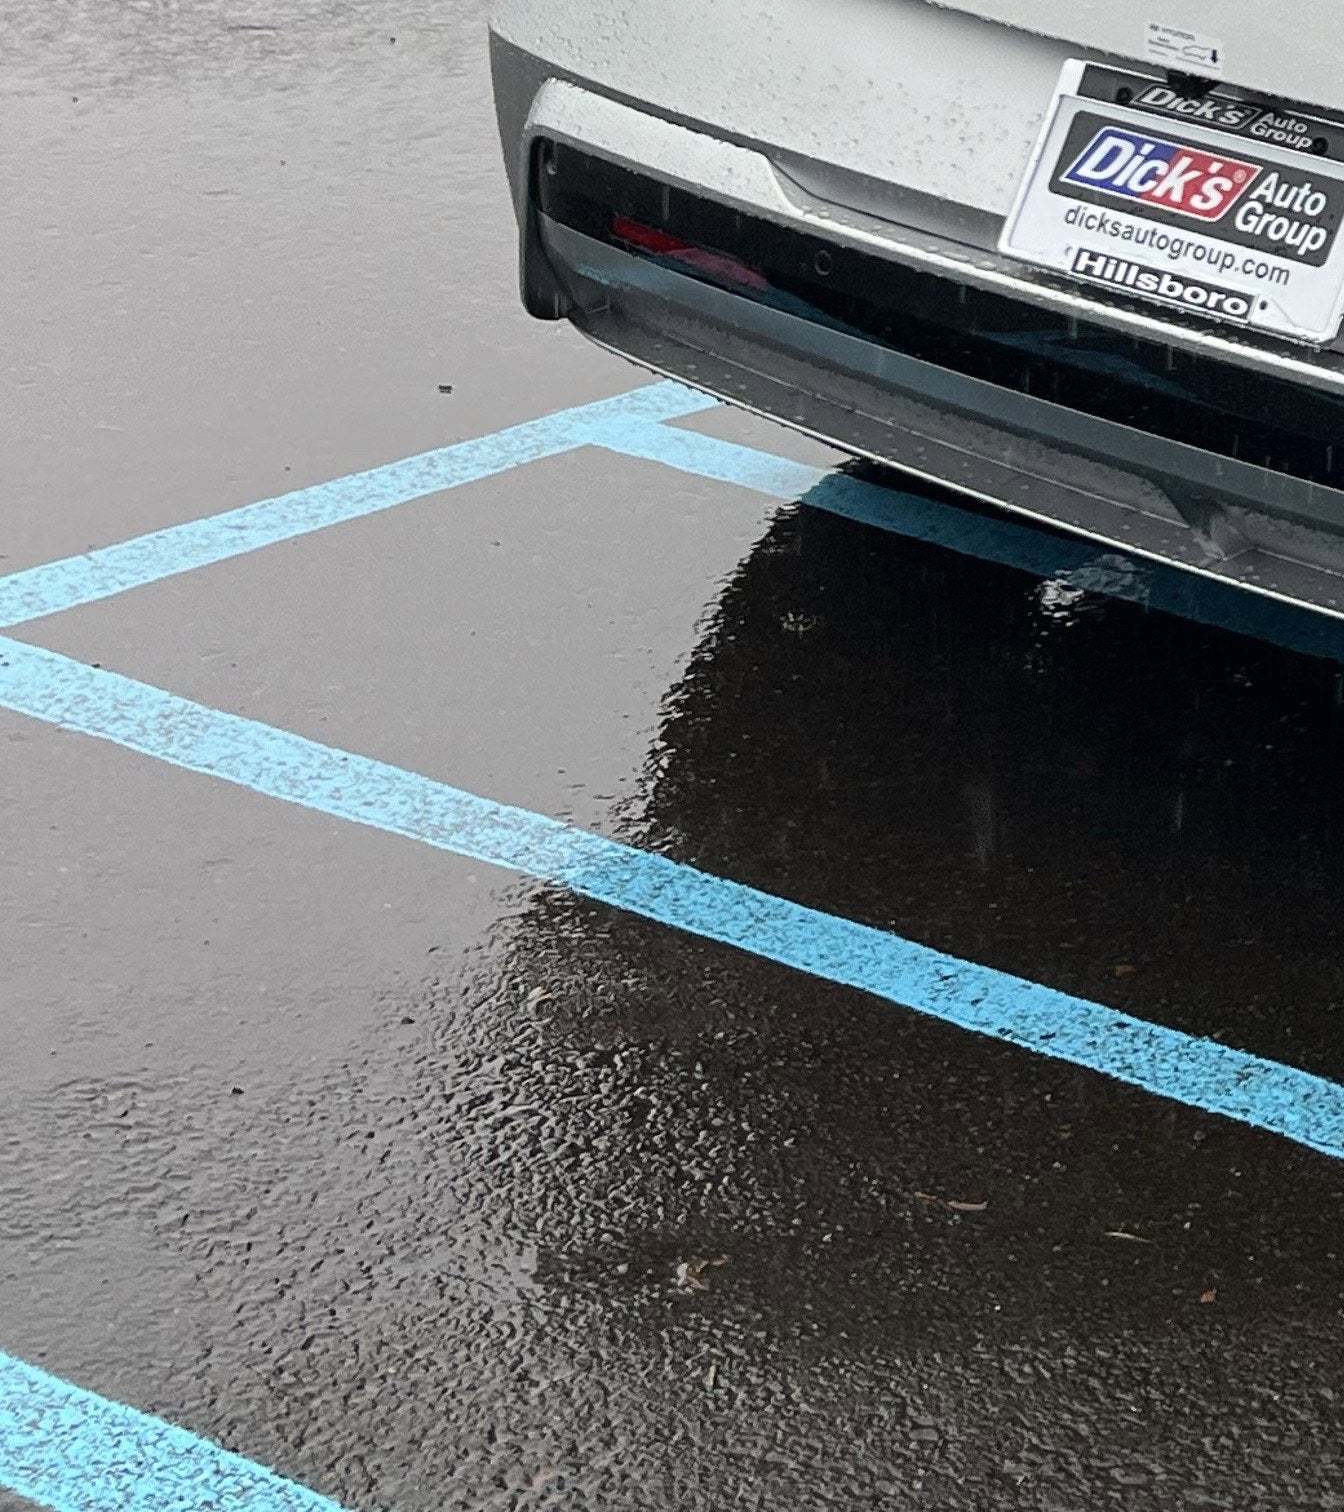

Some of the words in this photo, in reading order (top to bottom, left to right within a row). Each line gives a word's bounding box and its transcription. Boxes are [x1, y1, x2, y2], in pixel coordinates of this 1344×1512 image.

[1141, 87, 1247, 126] Dick's
[1258, 111, 1308, 135] Auto
[1251, 122, 1313, 149] Group
[1074, 135, 1235, 214] Dick's
[1247, 172, 1327, 216] Auto
[1064, 205, 1291, 286] dicksautogroup.com
[1234, 201, 1328, 257] Group
[1075, 249, 1251, 317] Hillsboro
